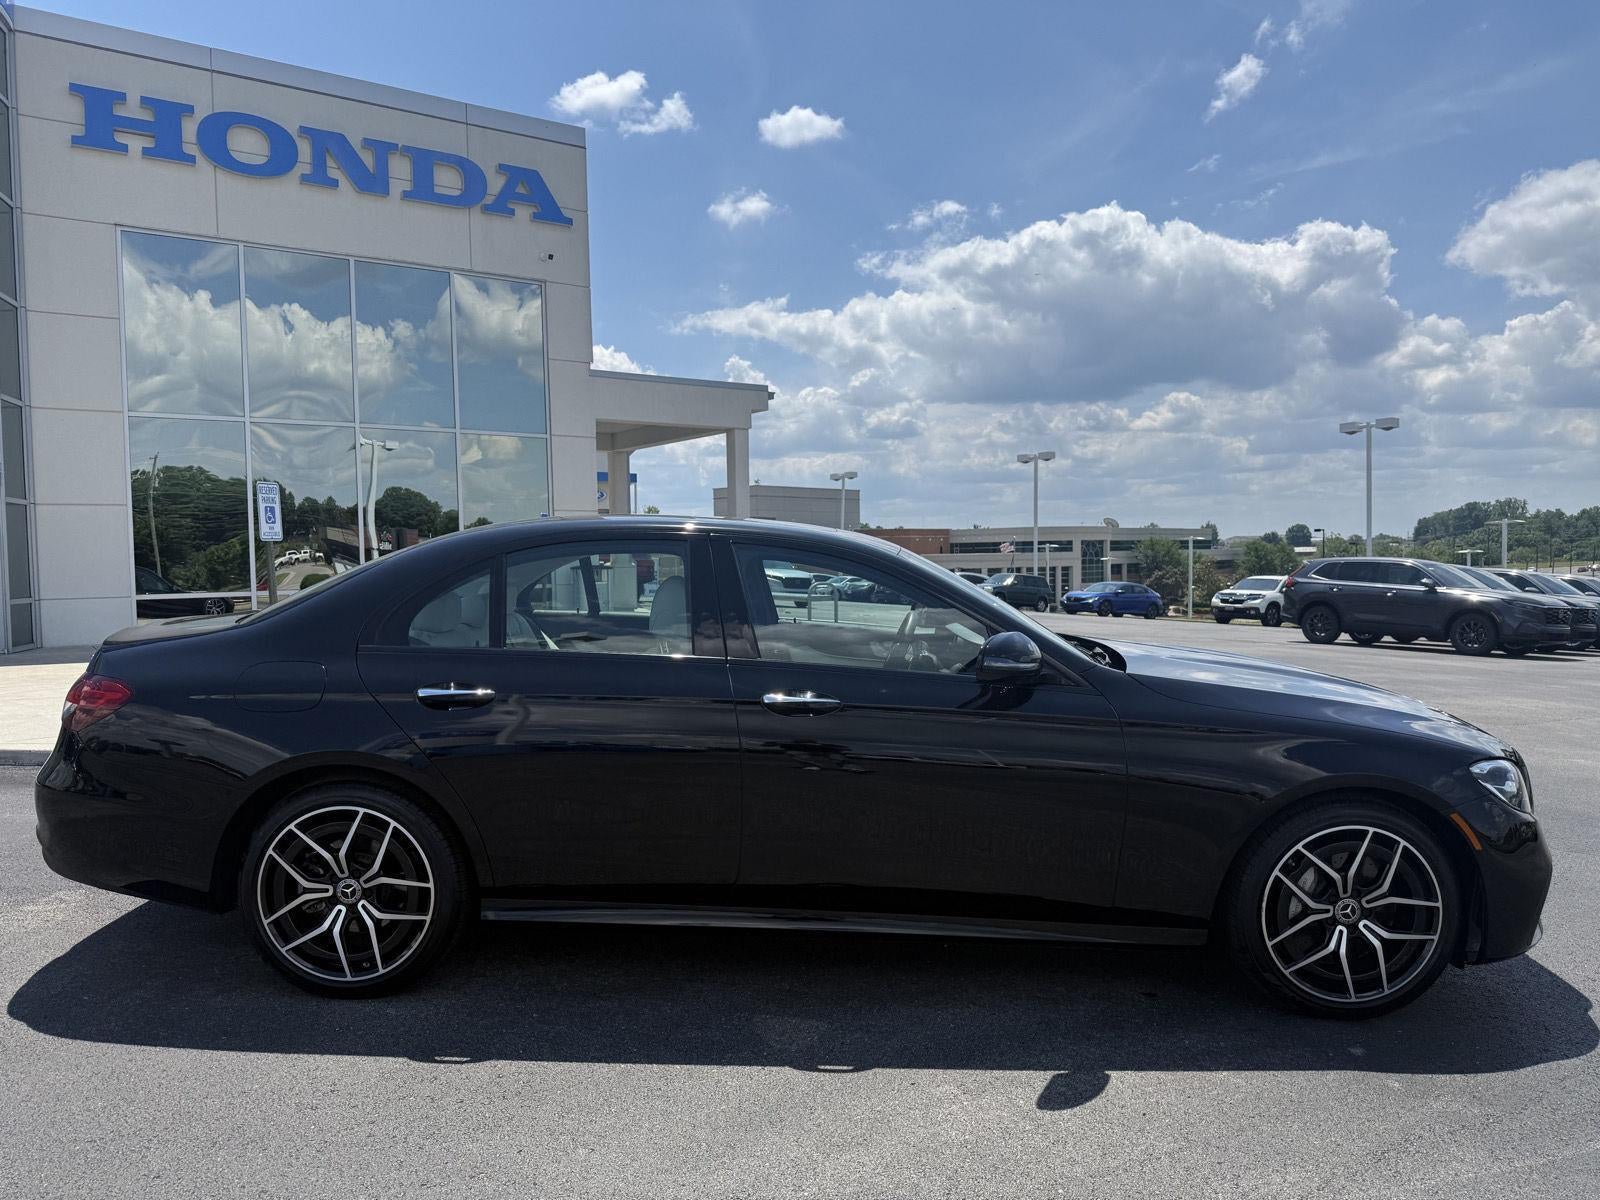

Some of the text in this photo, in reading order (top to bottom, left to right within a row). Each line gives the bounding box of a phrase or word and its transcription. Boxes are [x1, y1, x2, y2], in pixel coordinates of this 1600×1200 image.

[69, 82, 573, 226] HONDA
[259, 485, 277, 495] RESERVED
[261, 496, 277, 505] PARKING
